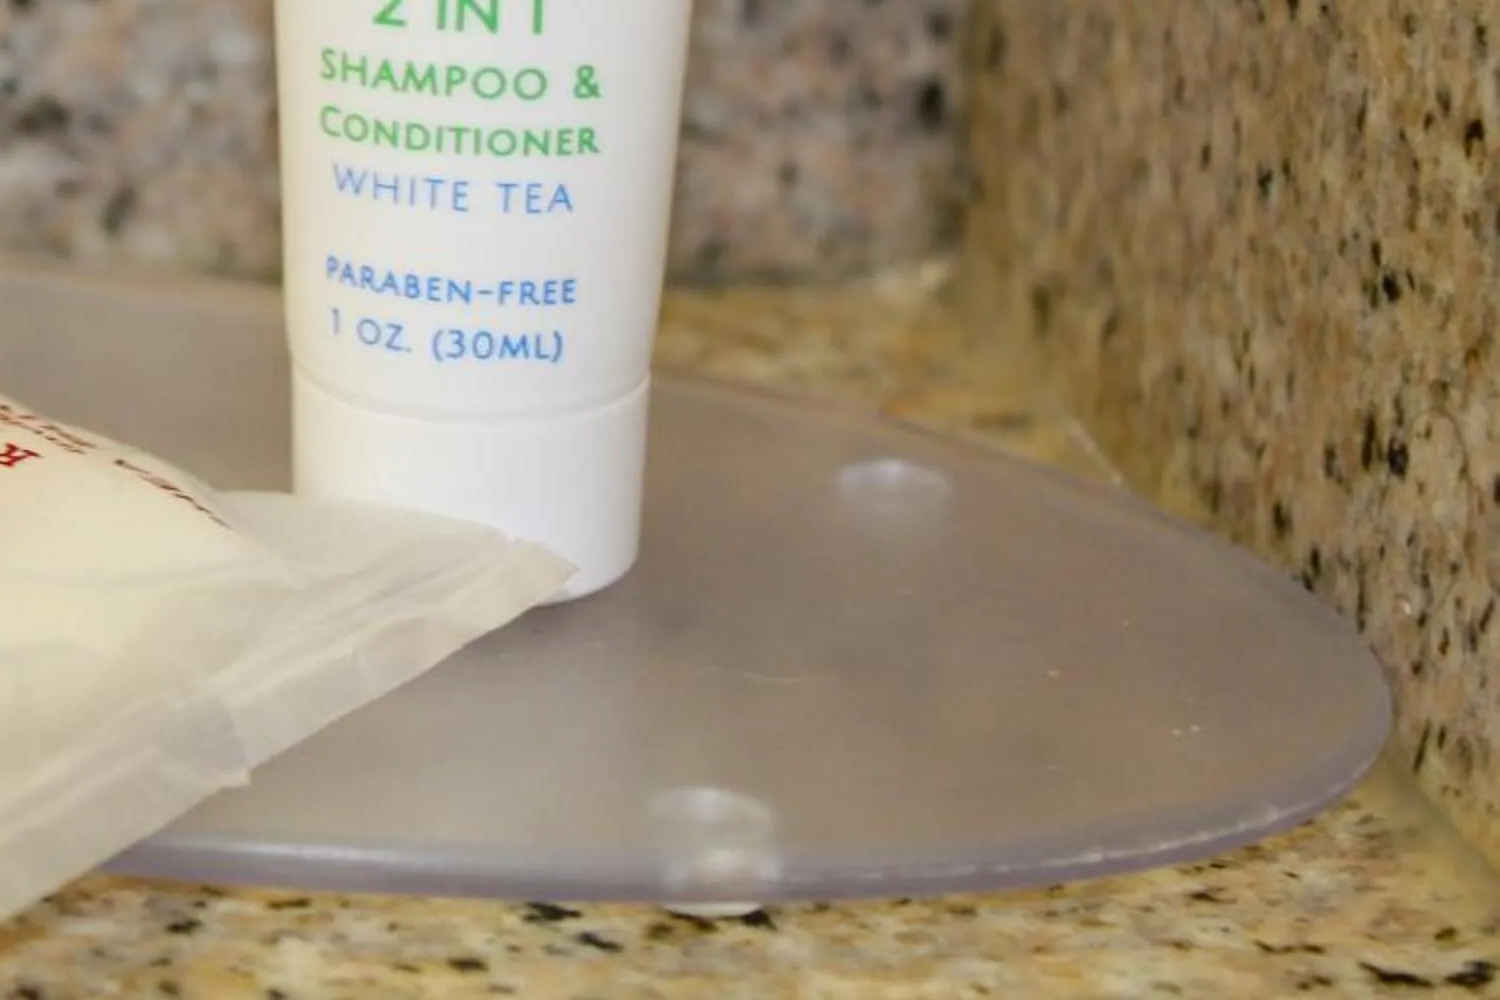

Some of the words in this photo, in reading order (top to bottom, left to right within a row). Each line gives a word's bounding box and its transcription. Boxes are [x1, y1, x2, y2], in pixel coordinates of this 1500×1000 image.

[320, 48, 549, 100] SHAMPOO
[573, 64, 602, 100] &
[320, 105, 600, 157] CONDITIONER
[333, 163, 470, 213] WHITE
[495, 182, 573, 215] TEA
[326, 255, 577, 306] PARABEN-FREE
[331, 307, 342, 335] 1
[356, 317, 412, 353] OZ.
[432, 329, 564, 364] (30ML)
